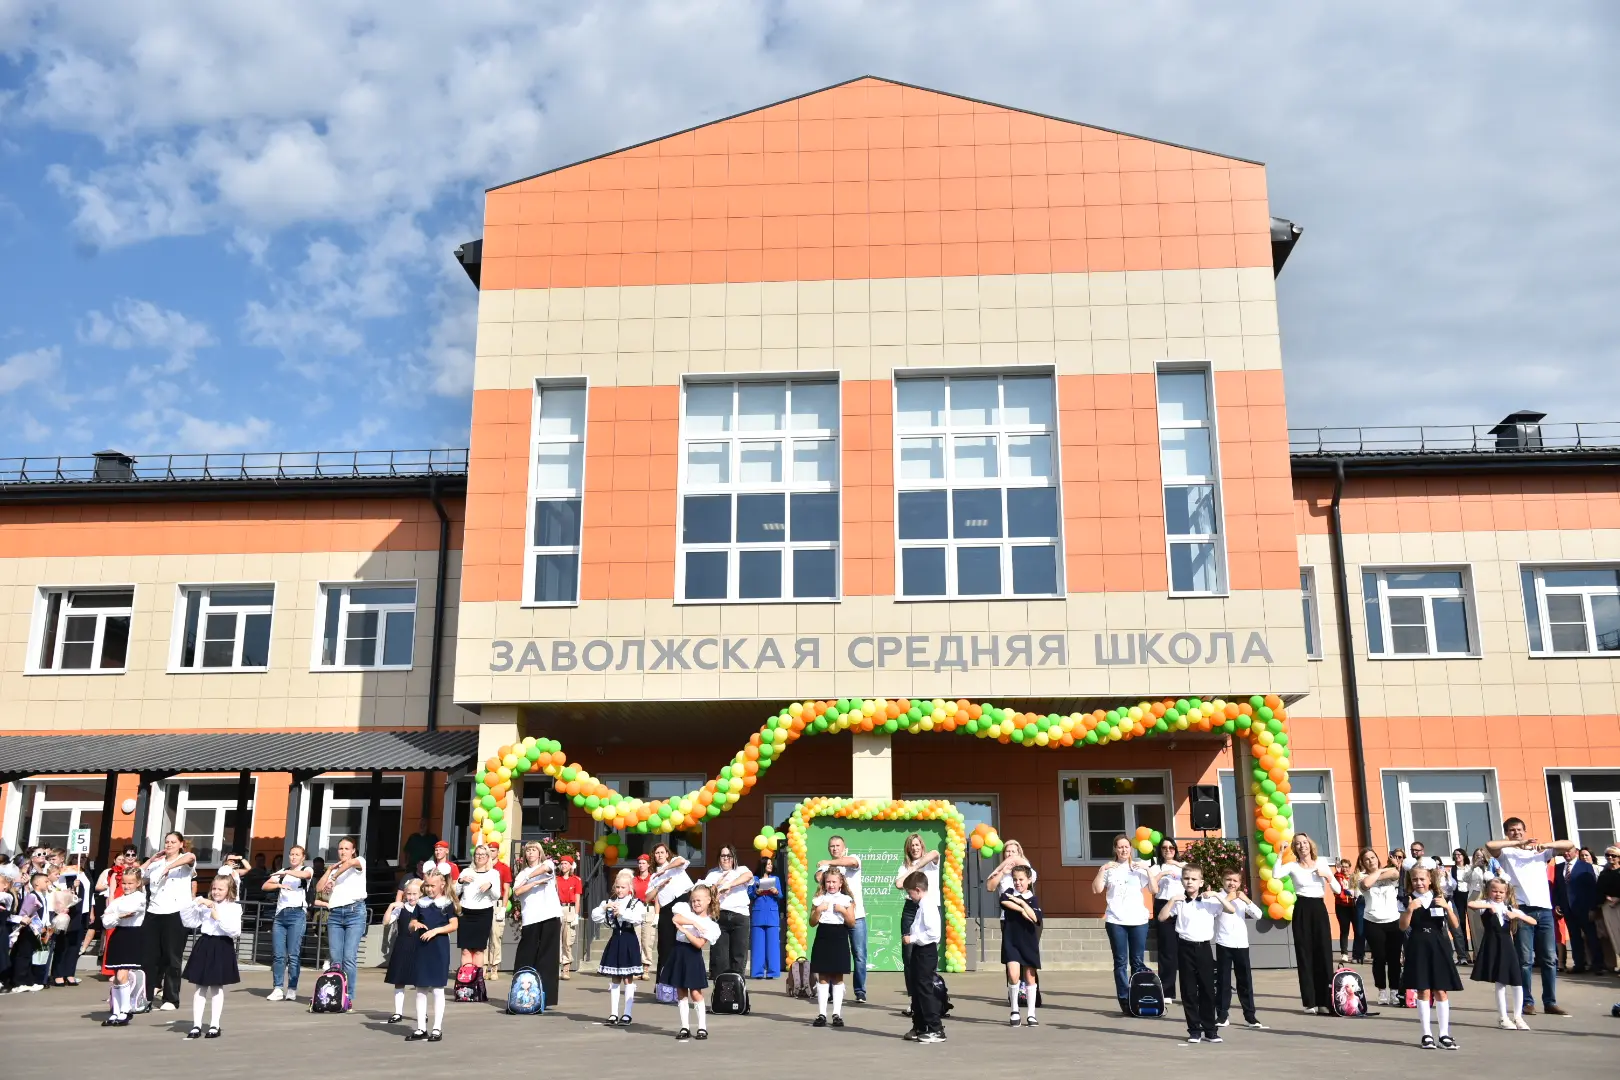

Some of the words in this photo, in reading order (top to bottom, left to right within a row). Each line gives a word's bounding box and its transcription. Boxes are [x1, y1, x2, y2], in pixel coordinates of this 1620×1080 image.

[489, 637, 820, 673] ЗАВОЛЖСКАЯ
[847, 634, 1066, 673] СРЕДНЯЯ
[1094, 631, 1274, 665] ШКОЛА
[77, 834, 85, 844] 5
[857, 851, 899, 863] ентября
[863, 883, 891, 895] кола!
